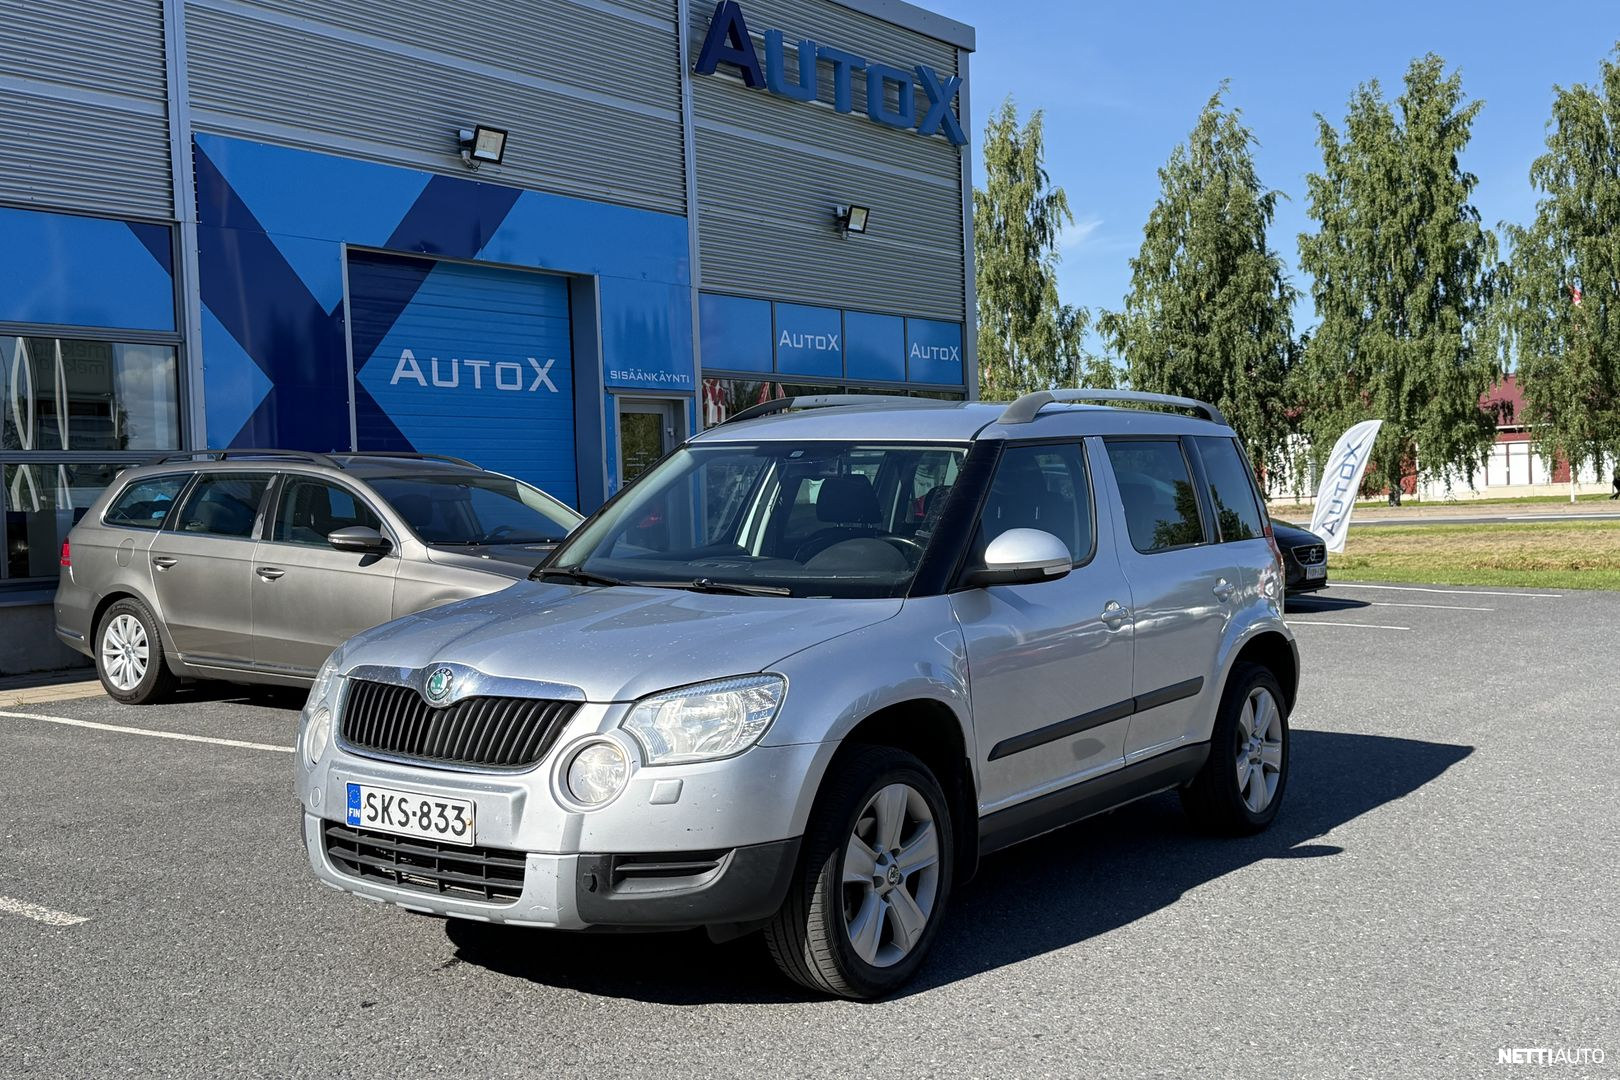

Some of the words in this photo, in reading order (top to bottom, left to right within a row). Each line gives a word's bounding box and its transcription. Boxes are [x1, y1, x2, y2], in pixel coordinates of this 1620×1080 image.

[694, 0, 968, 145] AUTOX
[779, 330, 839, 351] AUTOX
[910, 342, 960, 362] AUTOX
[390, 349, 559, 393] AUTOX
[610, 369, 690, 384] SISÄÄNKÄYNTI
[1322, 442, 1362, 536] AUTOX
[348, 807, 361, 818] FIN
[366, 792, 467, 837] SKS-833
